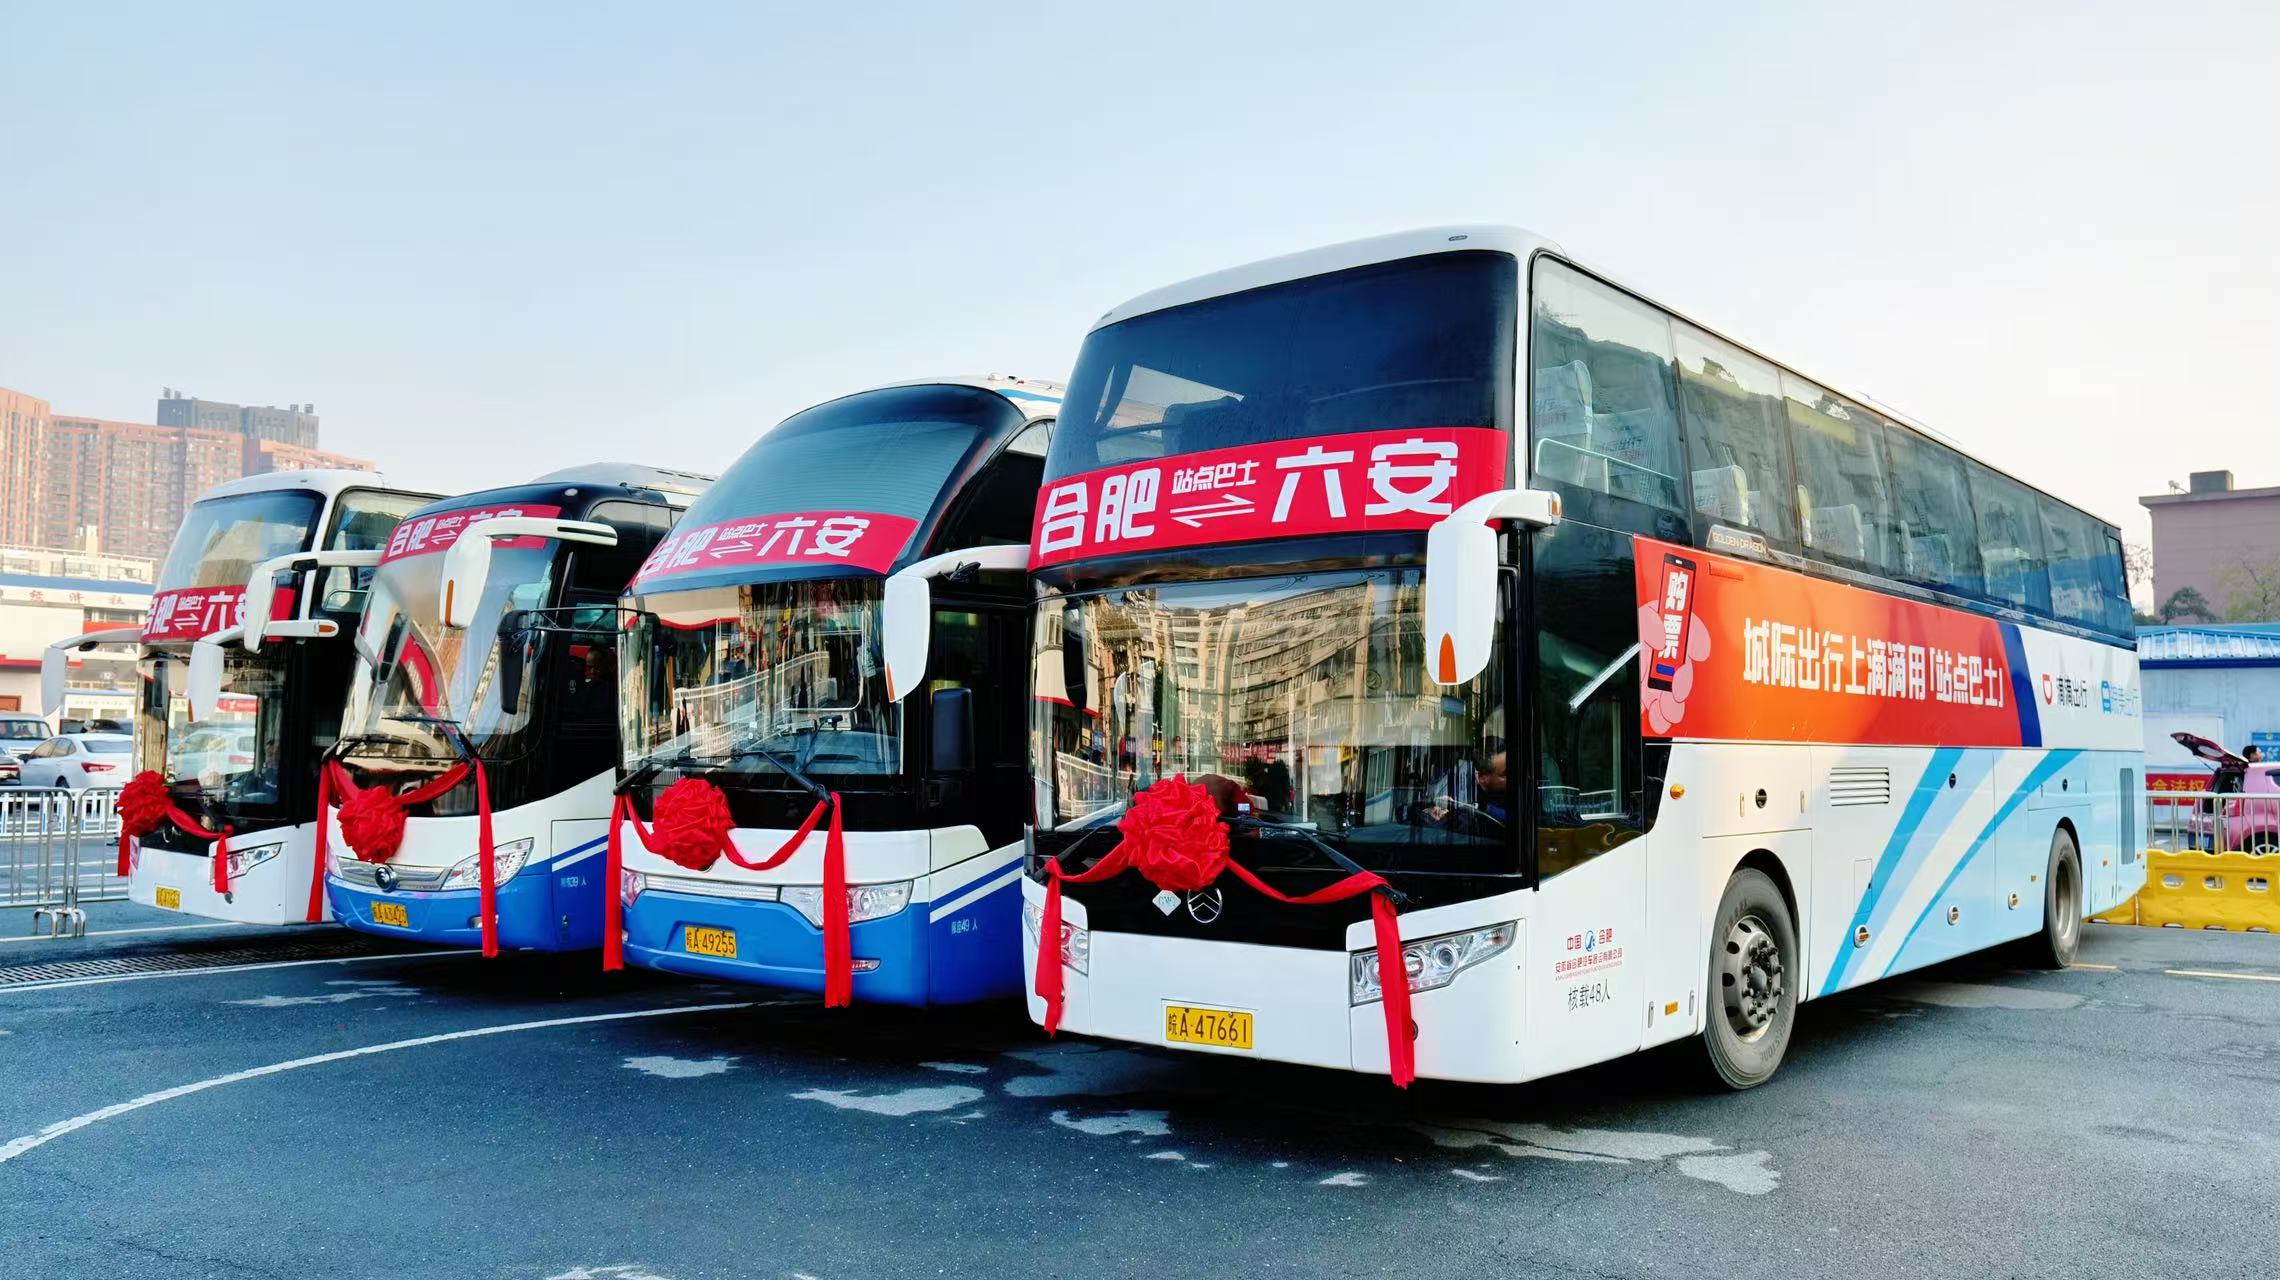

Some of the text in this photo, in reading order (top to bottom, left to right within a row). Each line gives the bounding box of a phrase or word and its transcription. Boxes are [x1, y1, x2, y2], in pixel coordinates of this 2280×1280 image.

[1039, 437, 1458, 555] 合肥 六安
[1171, 460, 1259, 494] 站点巴士
[388, 518, 437, 558] 合肥
[640, 516, 870, 575] 合肥 六安
[1713, 533, 1767, 553] GOLDEN DRAGON
[1658, 571, 1688, 659] 购票
[1568, 977, 1610, 1012] 核载48人
